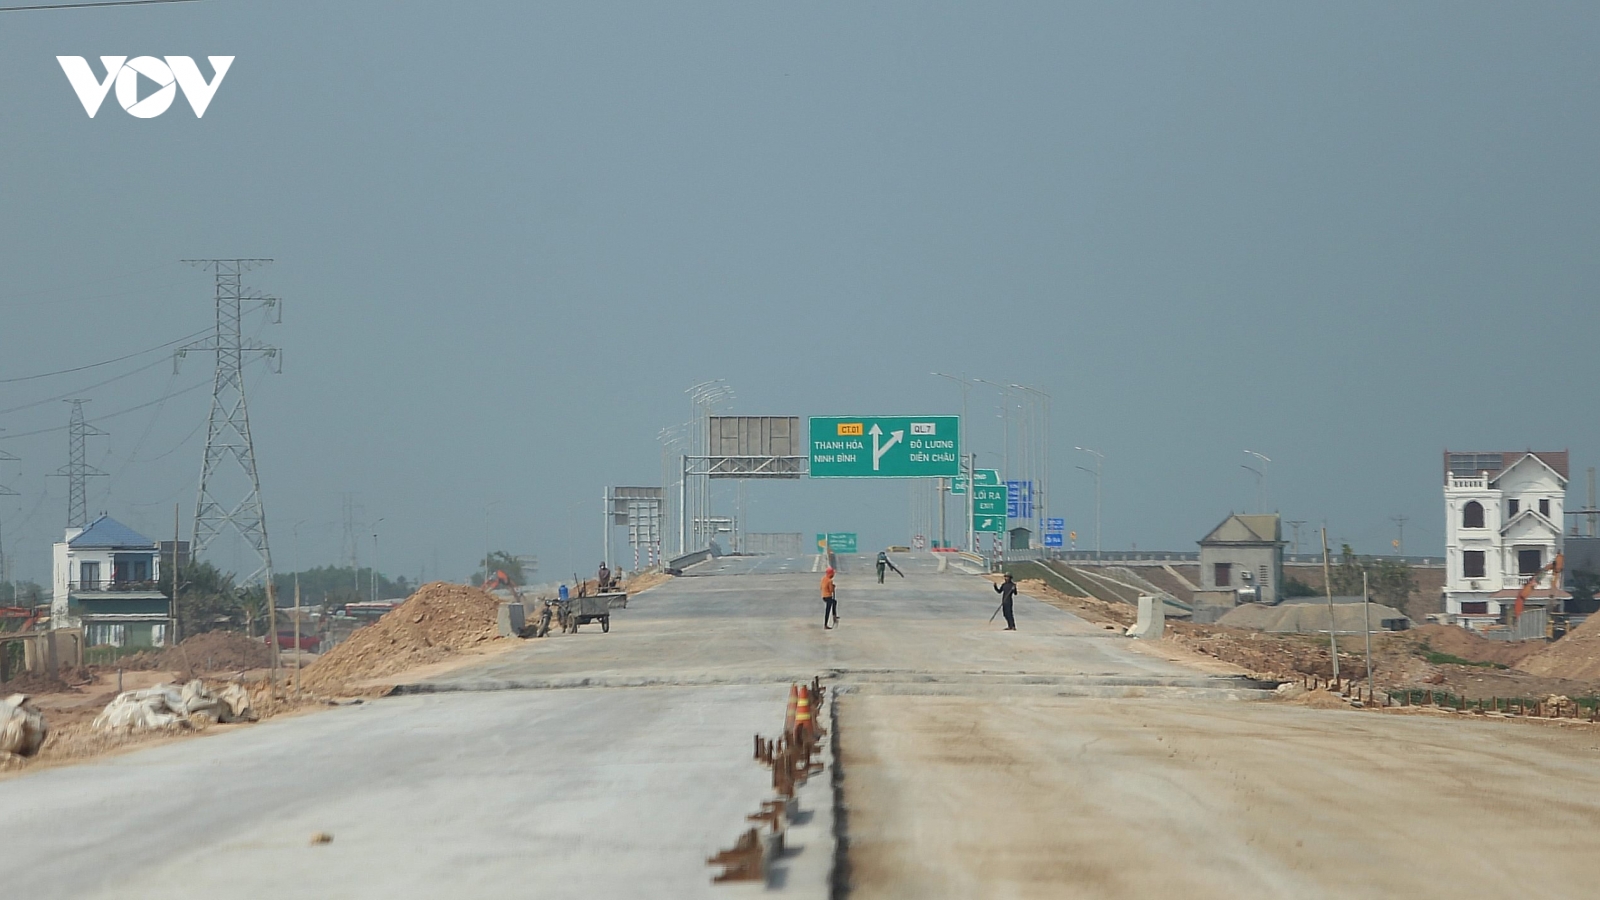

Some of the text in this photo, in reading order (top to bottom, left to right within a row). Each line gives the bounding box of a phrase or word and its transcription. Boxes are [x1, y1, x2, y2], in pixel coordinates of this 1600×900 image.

[841, 425, 859, 434] CT.01
[914, 425, 931, 433] QL.7
[814, 441, 844, 450] THANH
[910, 439, 921, 449] ĐÔ
[814, 453, 856, 463] NINH BÌNH
[931, 452, 955, 462] CHÂU
[989, 492, 1001, 500] RA
[980, 502, 994, 510] EXIT
